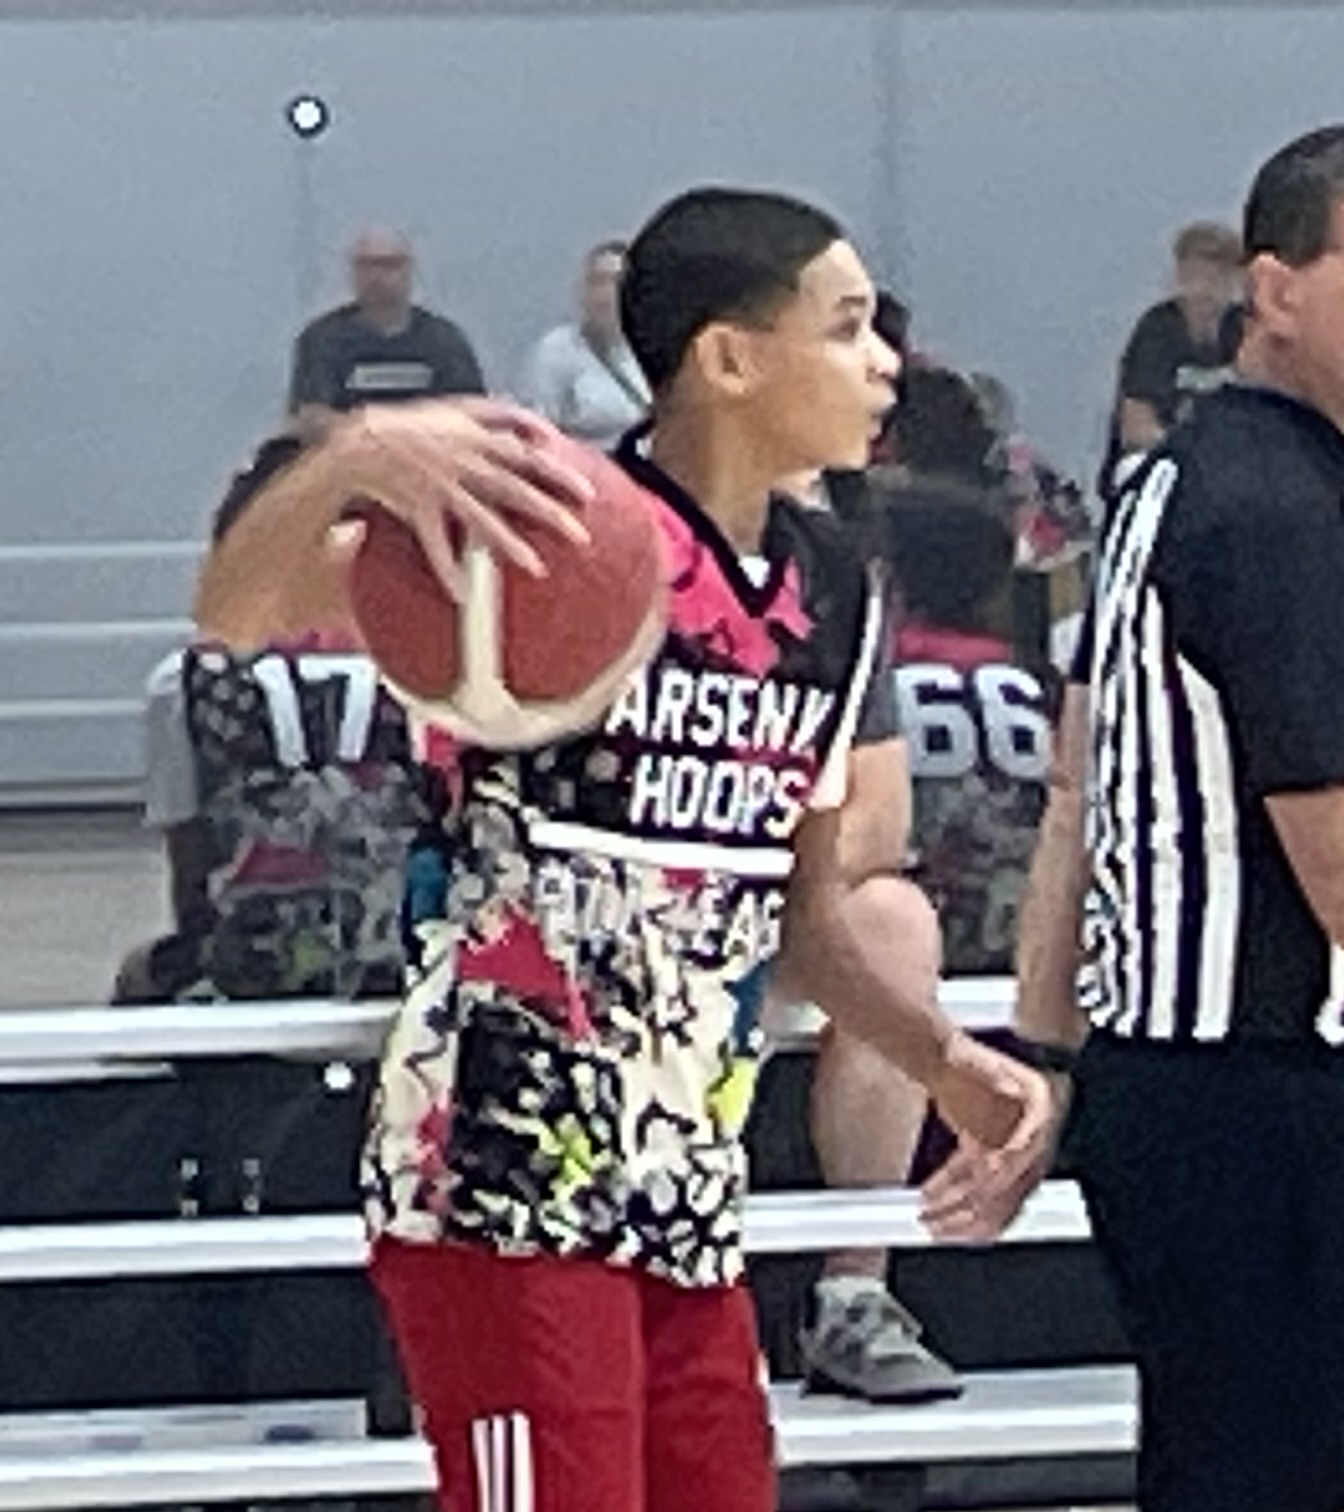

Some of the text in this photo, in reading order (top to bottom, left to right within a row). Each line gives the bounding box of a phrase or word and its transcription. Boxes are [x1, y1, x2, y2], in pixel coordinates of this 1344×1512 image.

[253, 656, 377, 767] 17
[894, 663, 1053, 778] 66
[629, 754, 809, 838] HOOPS
